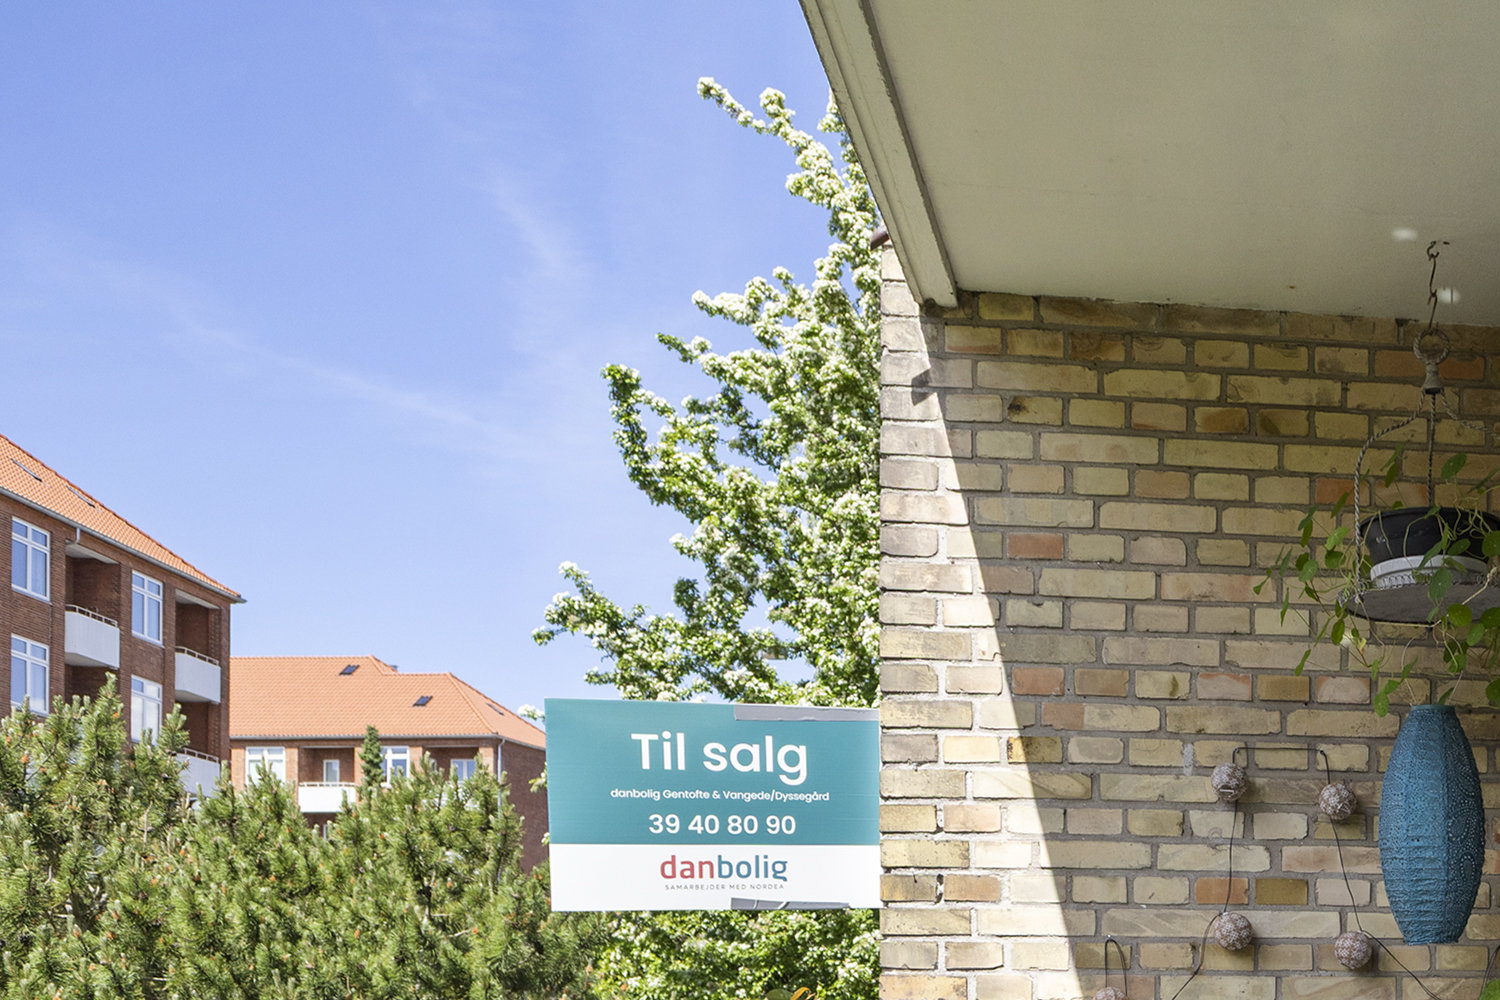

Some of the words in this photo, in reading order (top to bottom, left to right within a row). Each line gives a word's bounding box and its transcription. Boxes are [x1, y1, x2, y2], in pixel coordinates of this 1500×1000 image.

[630, 730, 686, 771] Til
[702, 735, 808, 786] salg
[610, 788, 661, 801] danbolig
[662, 789, 710, 800] Gentofte
[711, 791, 721, 800] &
[722, 789, 830, 803] Vangede/Dyssegård
[648, 813, 681, 835] 39
[687, 814, 720, 835] 40
[727, 815, 759, 835] 80
[766, 815, 797, 835] 90
[660, 854, 788, 882] danbolig
[664, 883, 726, 891] SAMARBEJDER
